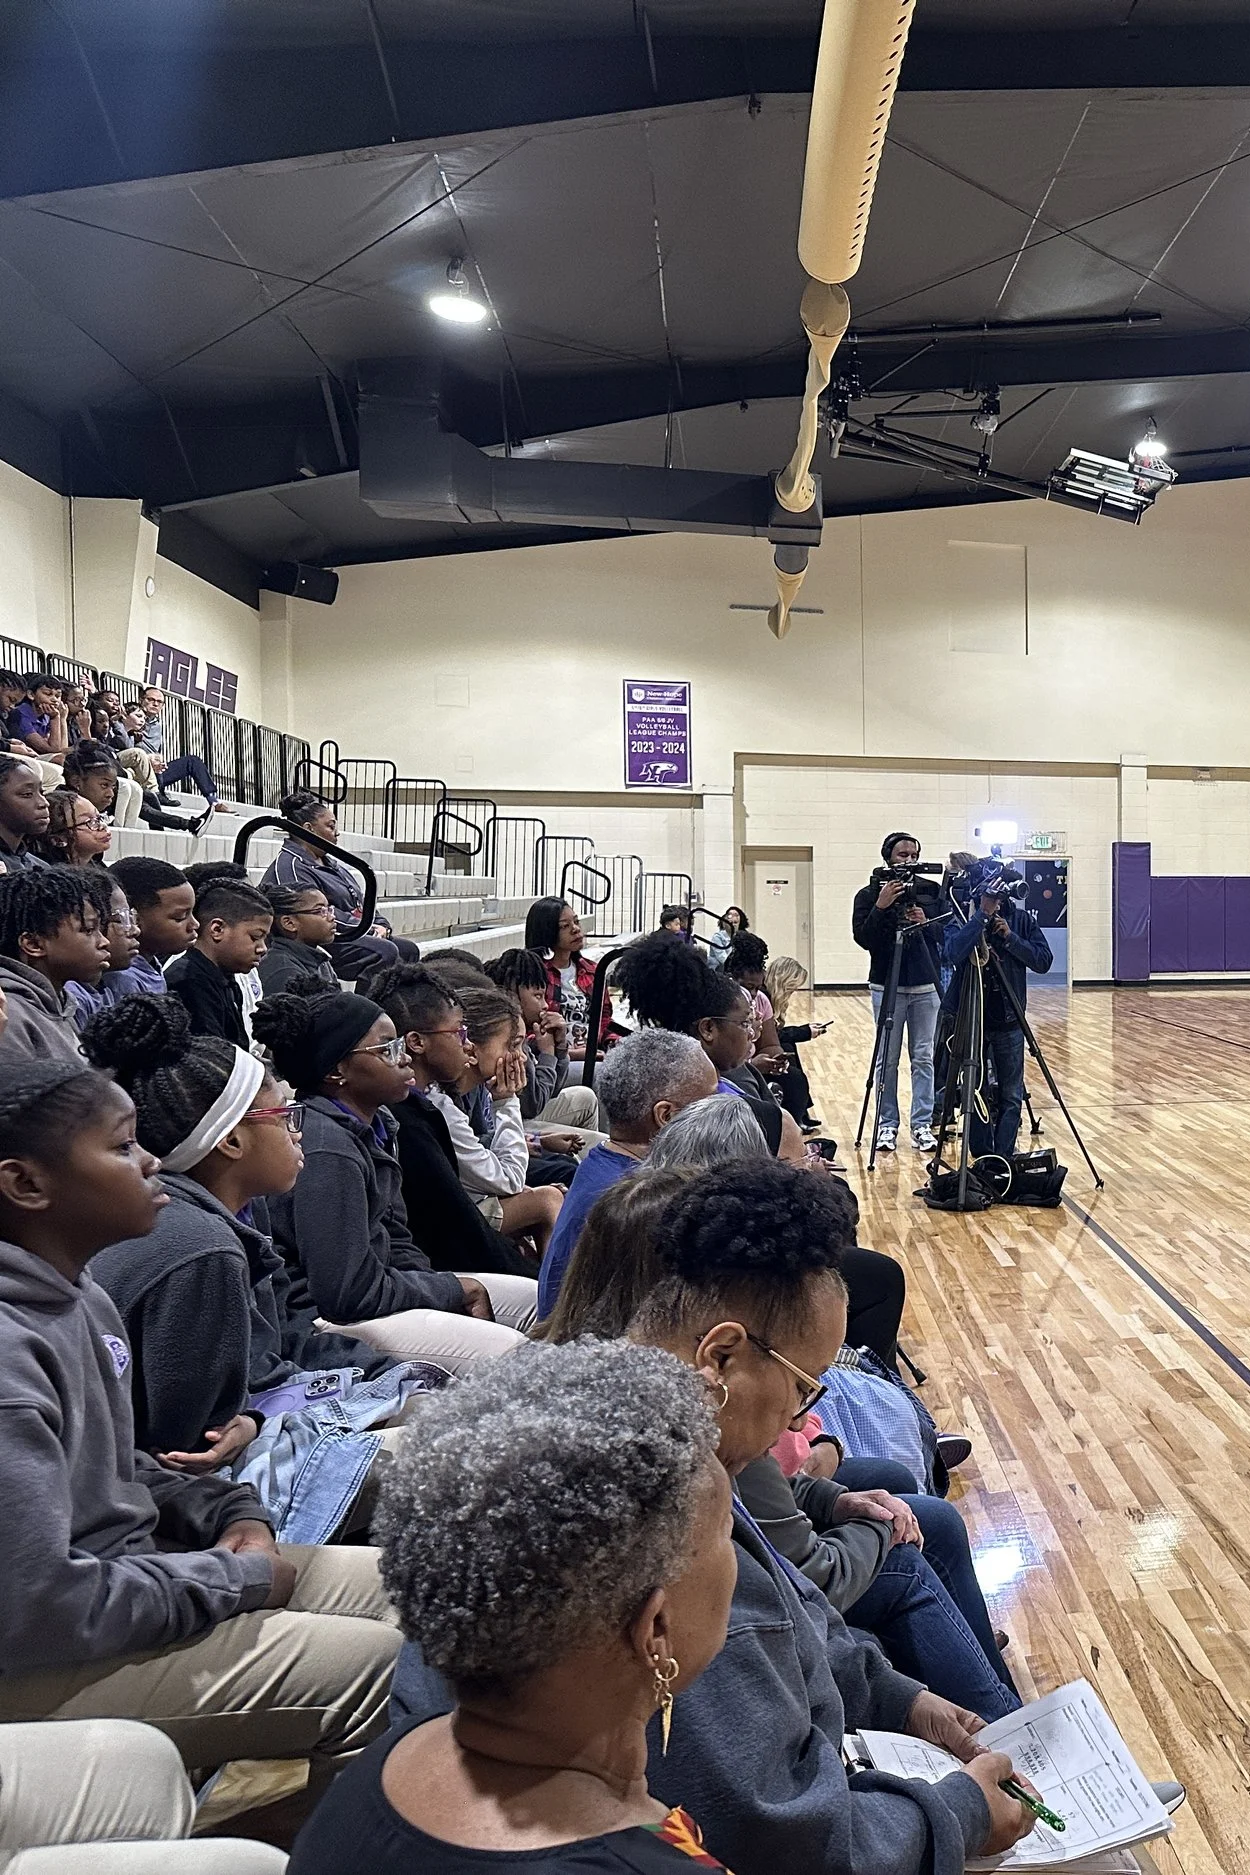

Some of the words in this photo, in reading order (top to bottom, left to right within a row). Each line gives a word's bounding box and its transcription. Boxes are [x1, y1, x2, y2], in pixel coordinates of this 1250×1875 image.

[144, 637, 238, 714] AGLES
[631, 741, 655, 753] 2023
[662, 742, 685, 754] 2024
